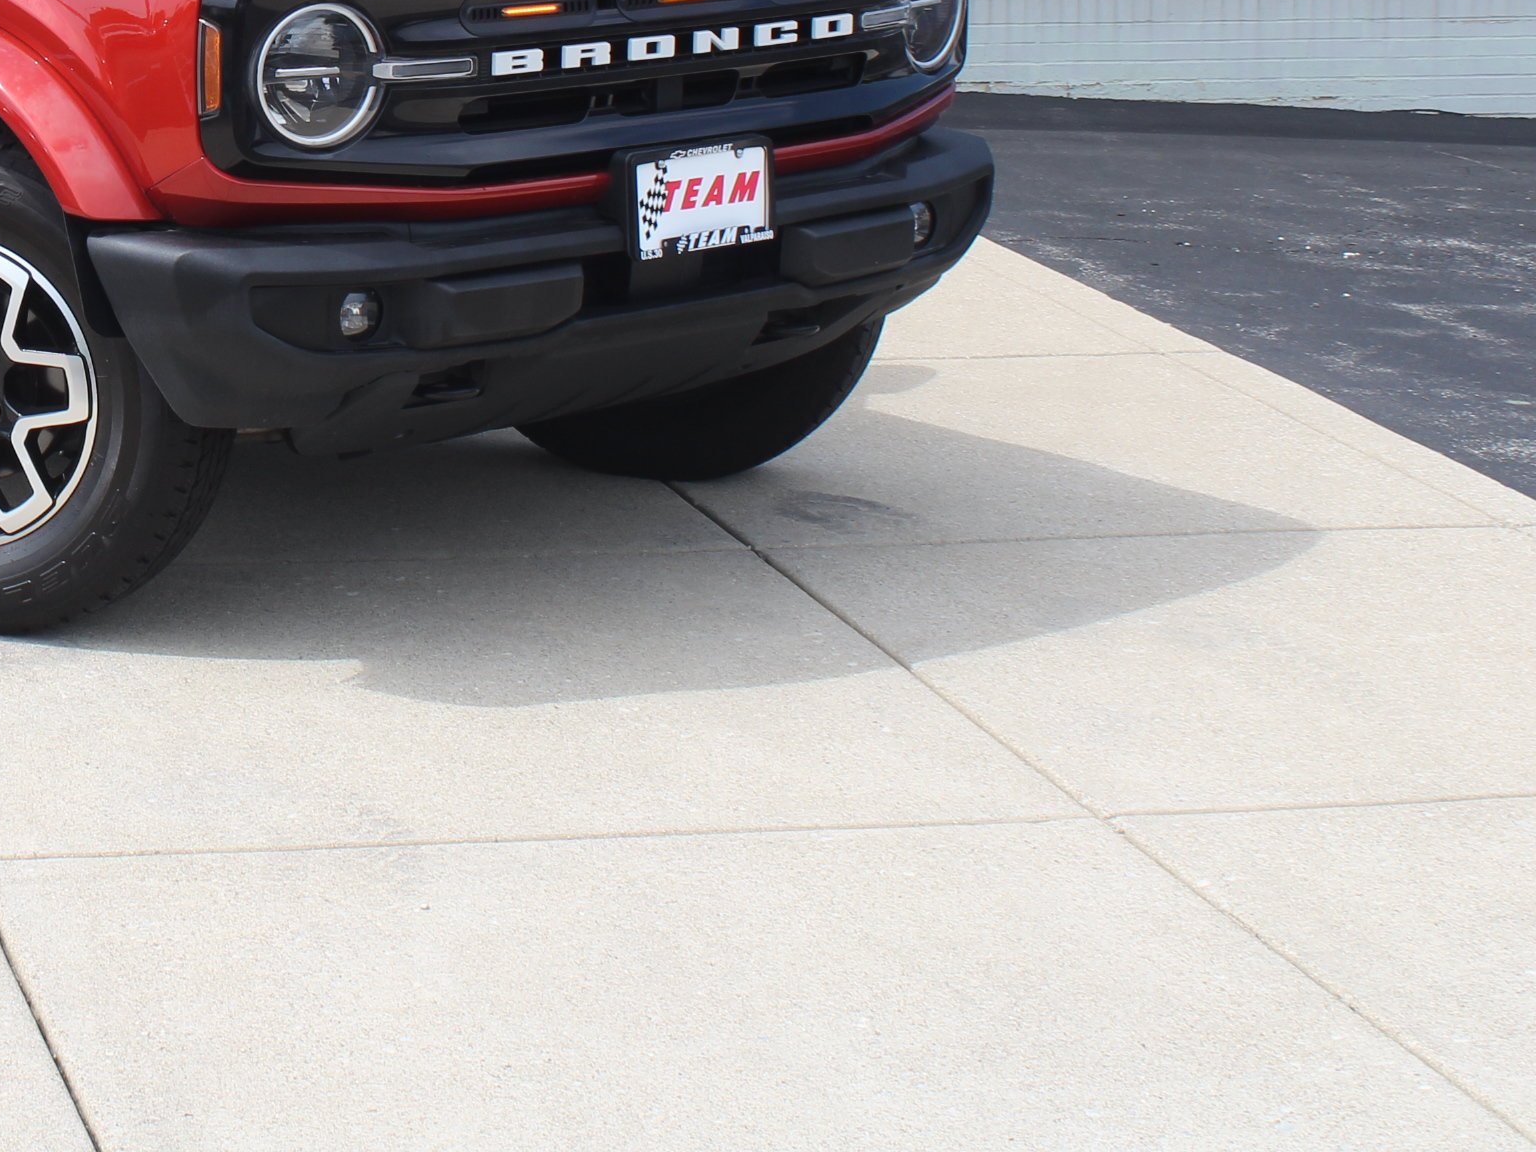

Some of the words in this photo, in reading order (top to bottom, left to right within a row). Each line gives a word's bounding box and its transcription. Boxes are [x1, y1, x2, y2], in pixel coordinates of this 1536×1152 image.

[491, 13, 854, 77] BRONCO
[686, 143, 734, 157] CHEVROLET
[663, 171, 761, 213] TEAM
[687, 226, 738, 250] TEAM
[739, 230, 775, 244] VALPARAISO
